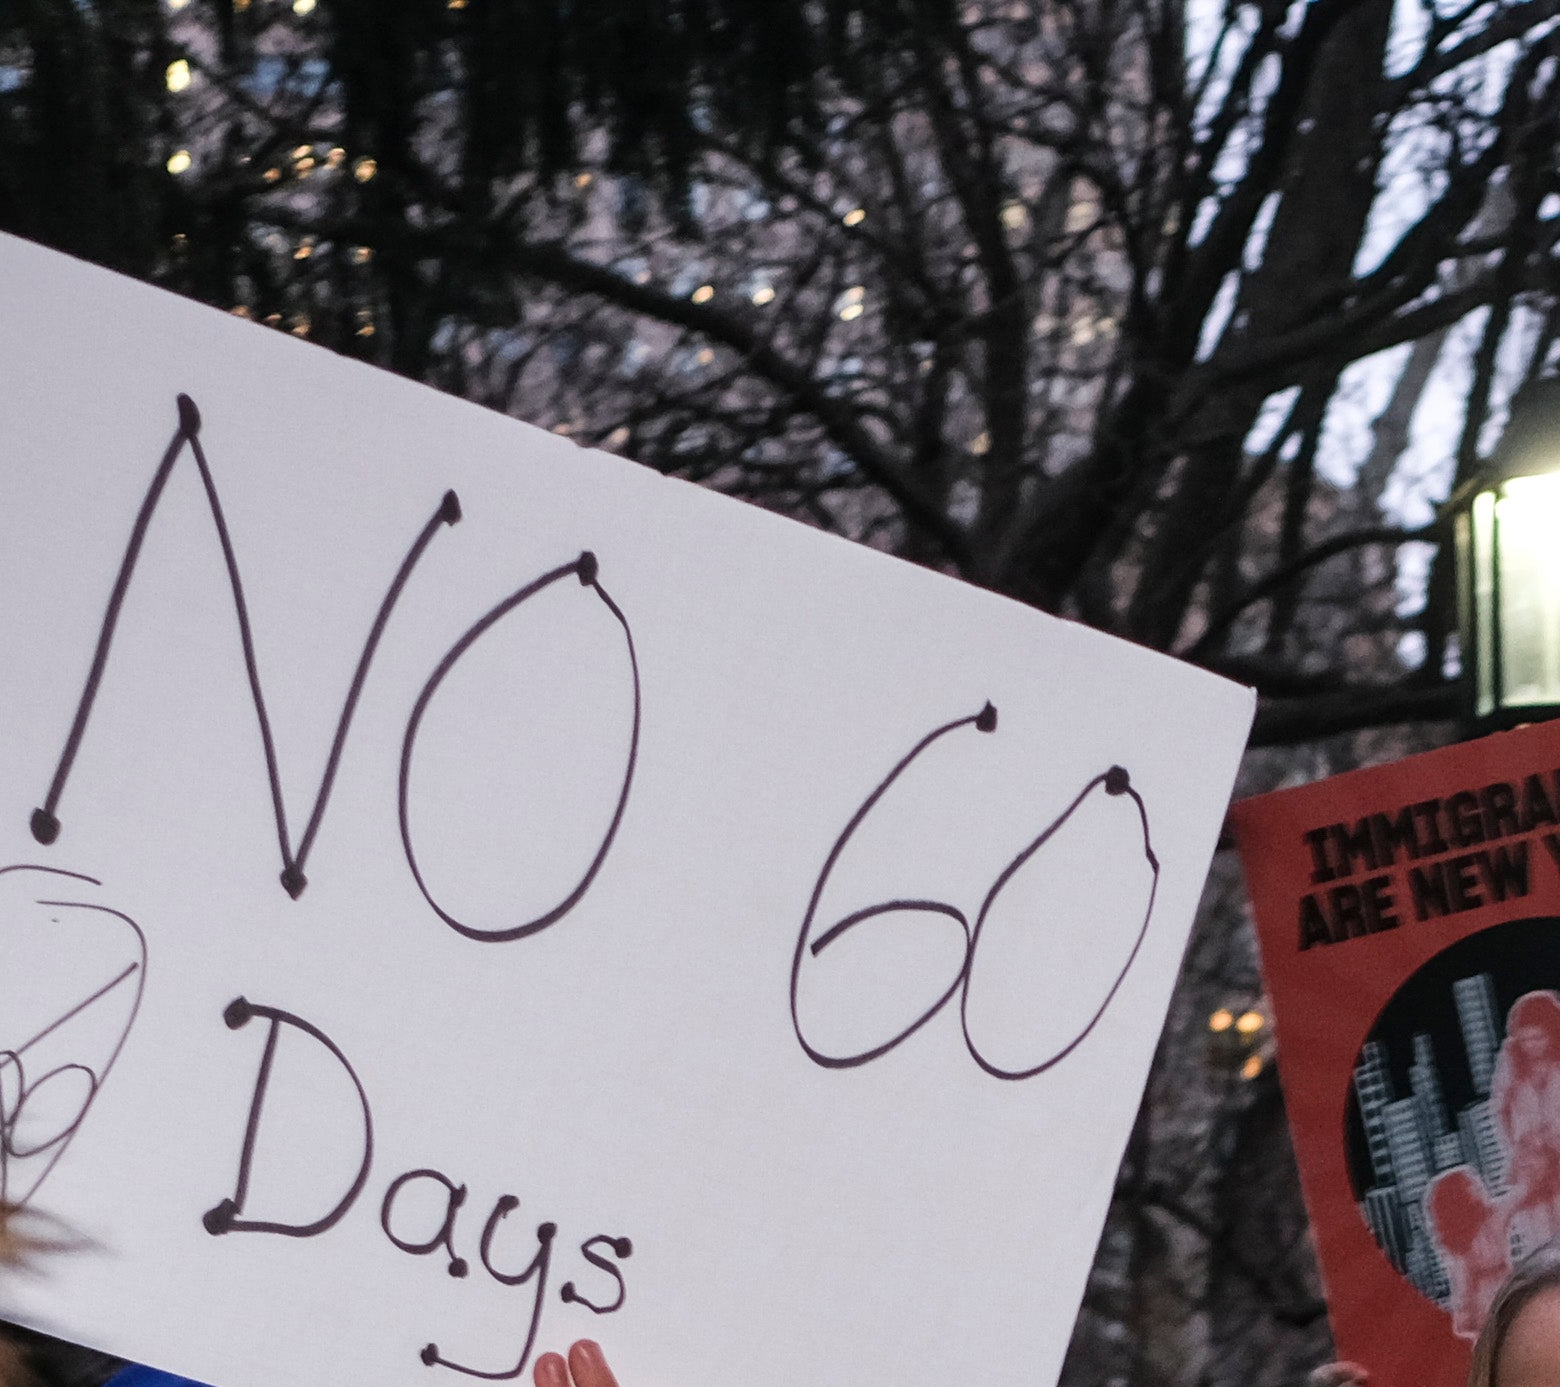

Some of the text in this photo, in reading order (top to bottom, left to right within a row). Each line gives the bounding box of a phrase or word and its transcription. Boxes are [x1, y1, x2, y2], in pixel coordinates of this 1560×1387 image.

[30, 394, 1160, 1081] NO 60
[1298, 874, 1402, 952] ARE
[1408, 838, 1530, 922] NEW
[202, 995, 633, 1380] Days
